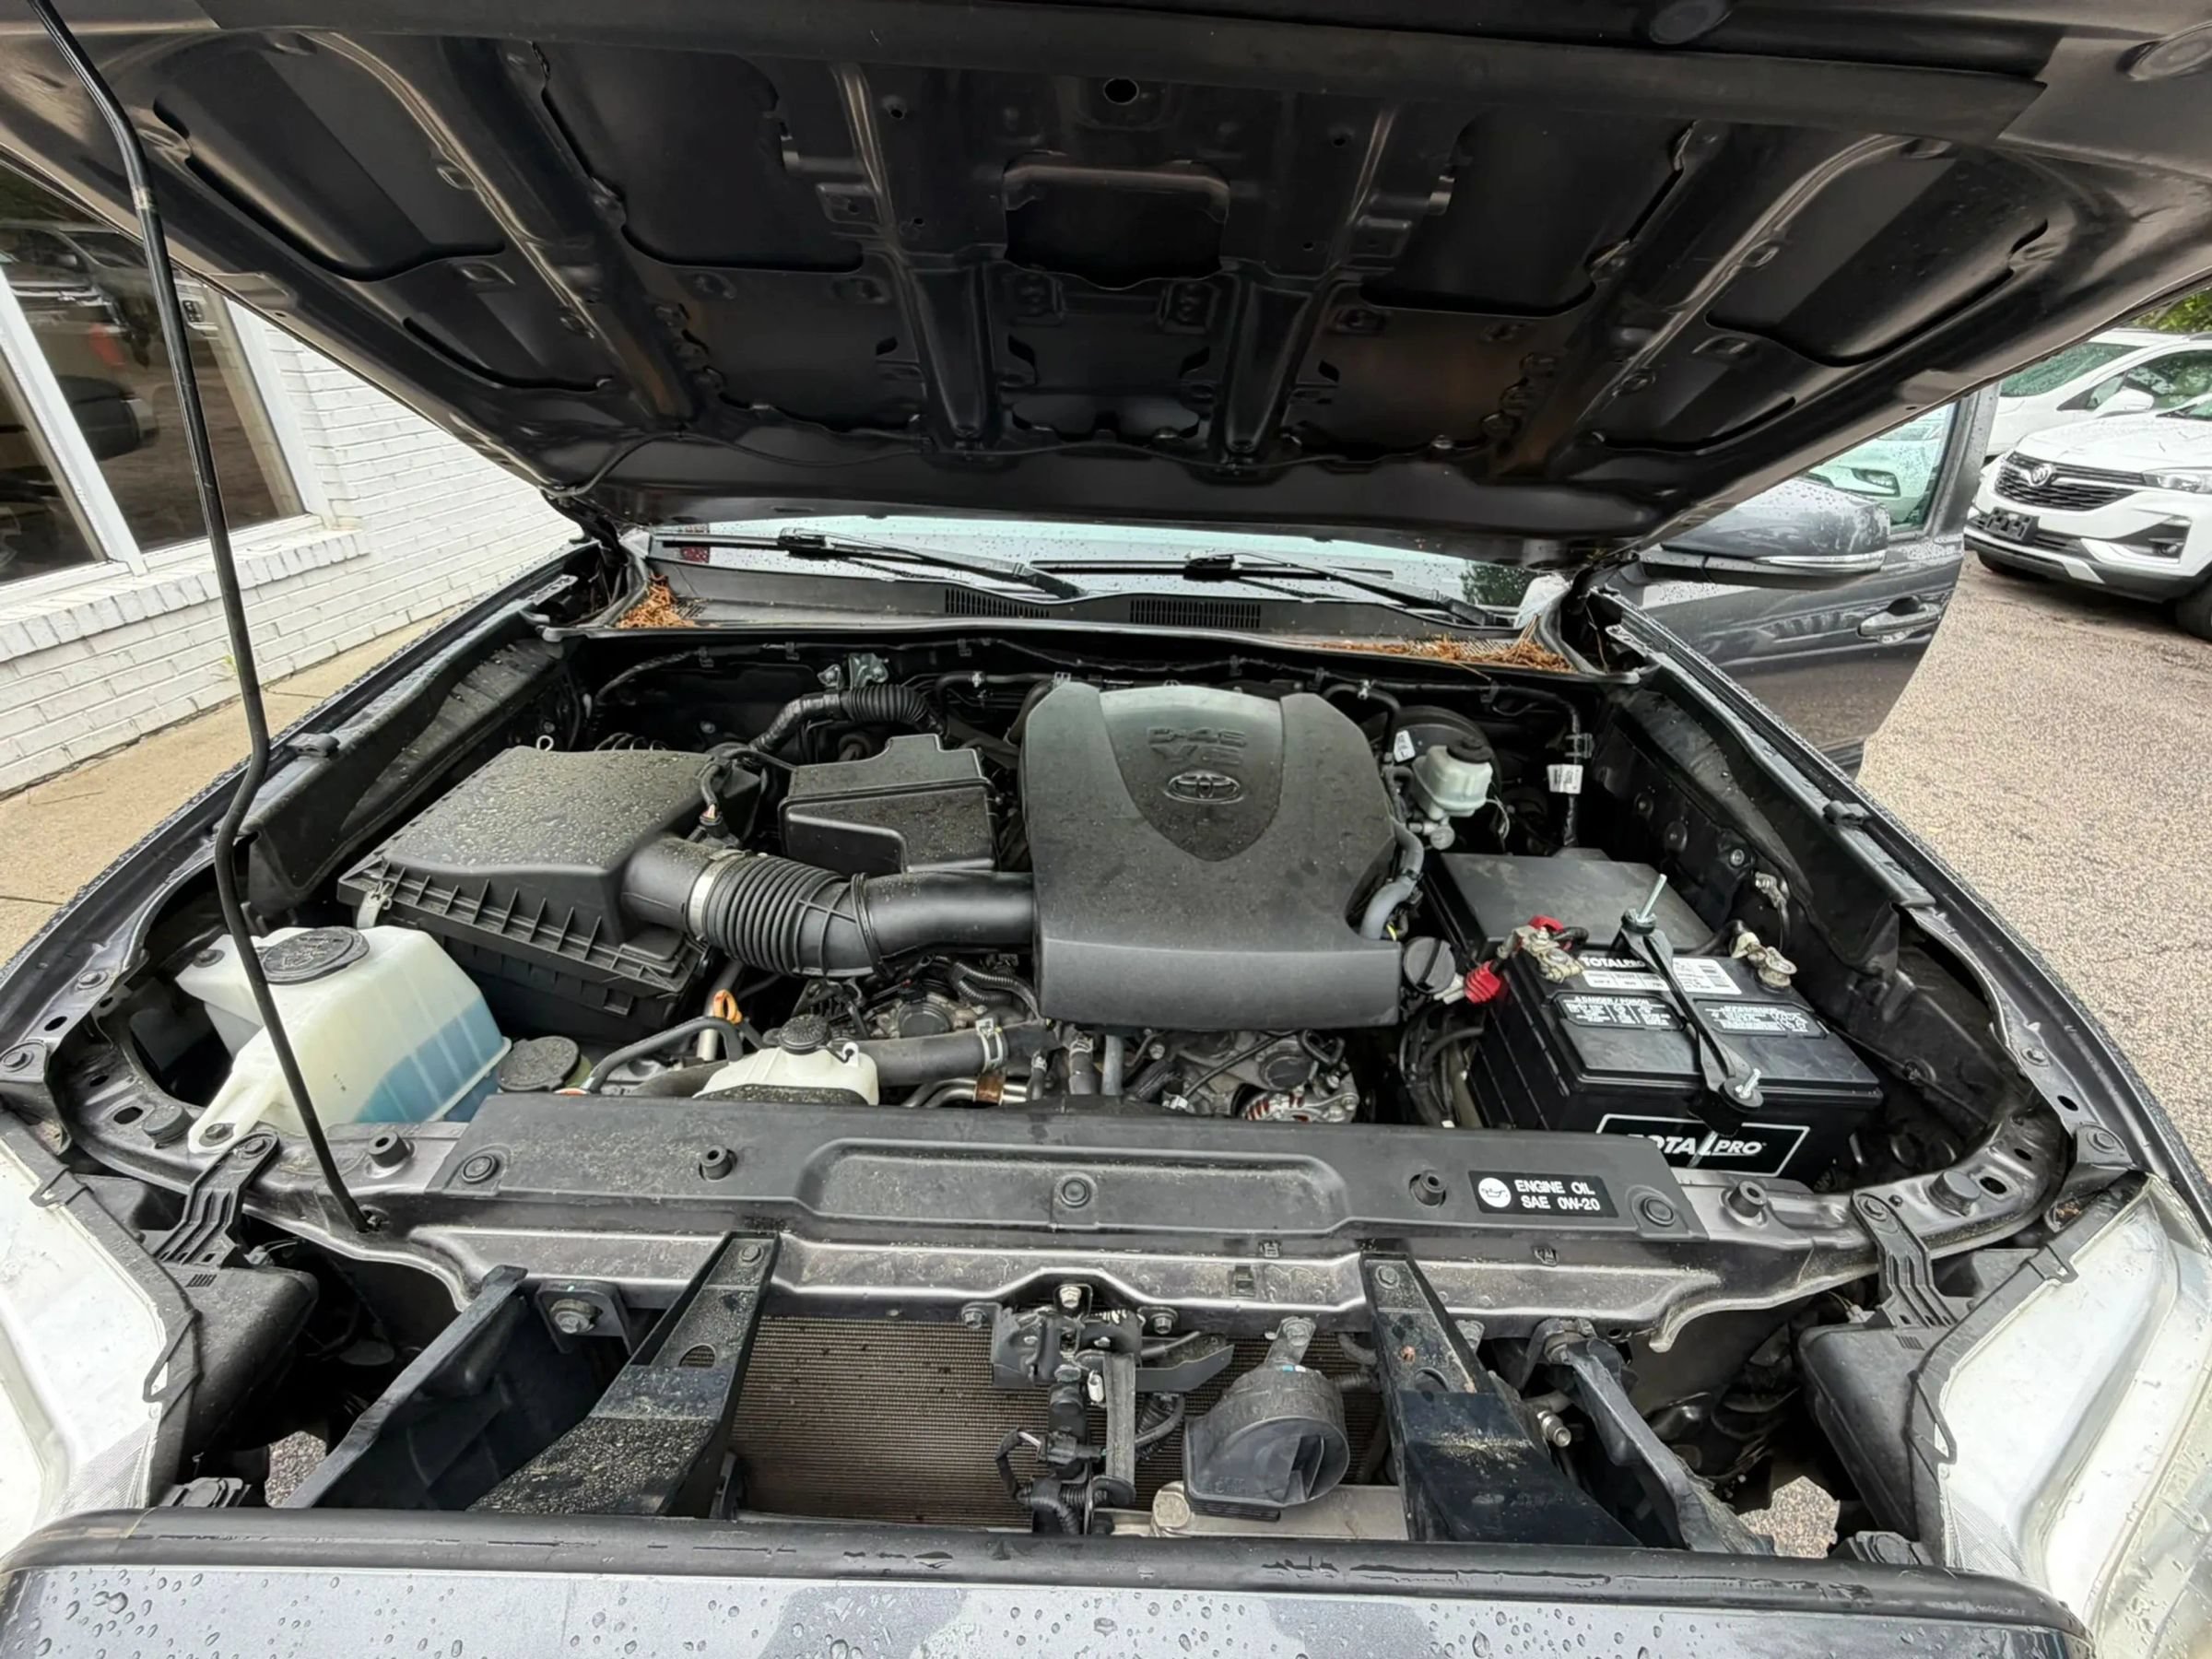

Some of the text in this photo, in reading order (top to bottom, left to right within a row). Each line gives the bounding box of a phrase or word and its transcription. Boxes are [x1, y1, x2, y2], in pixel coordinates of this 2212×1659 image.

[1514, 1180, 1596, 1194] ENGINE OIL
[1521, 1195, 1601, 1211] SAE 0W-20
